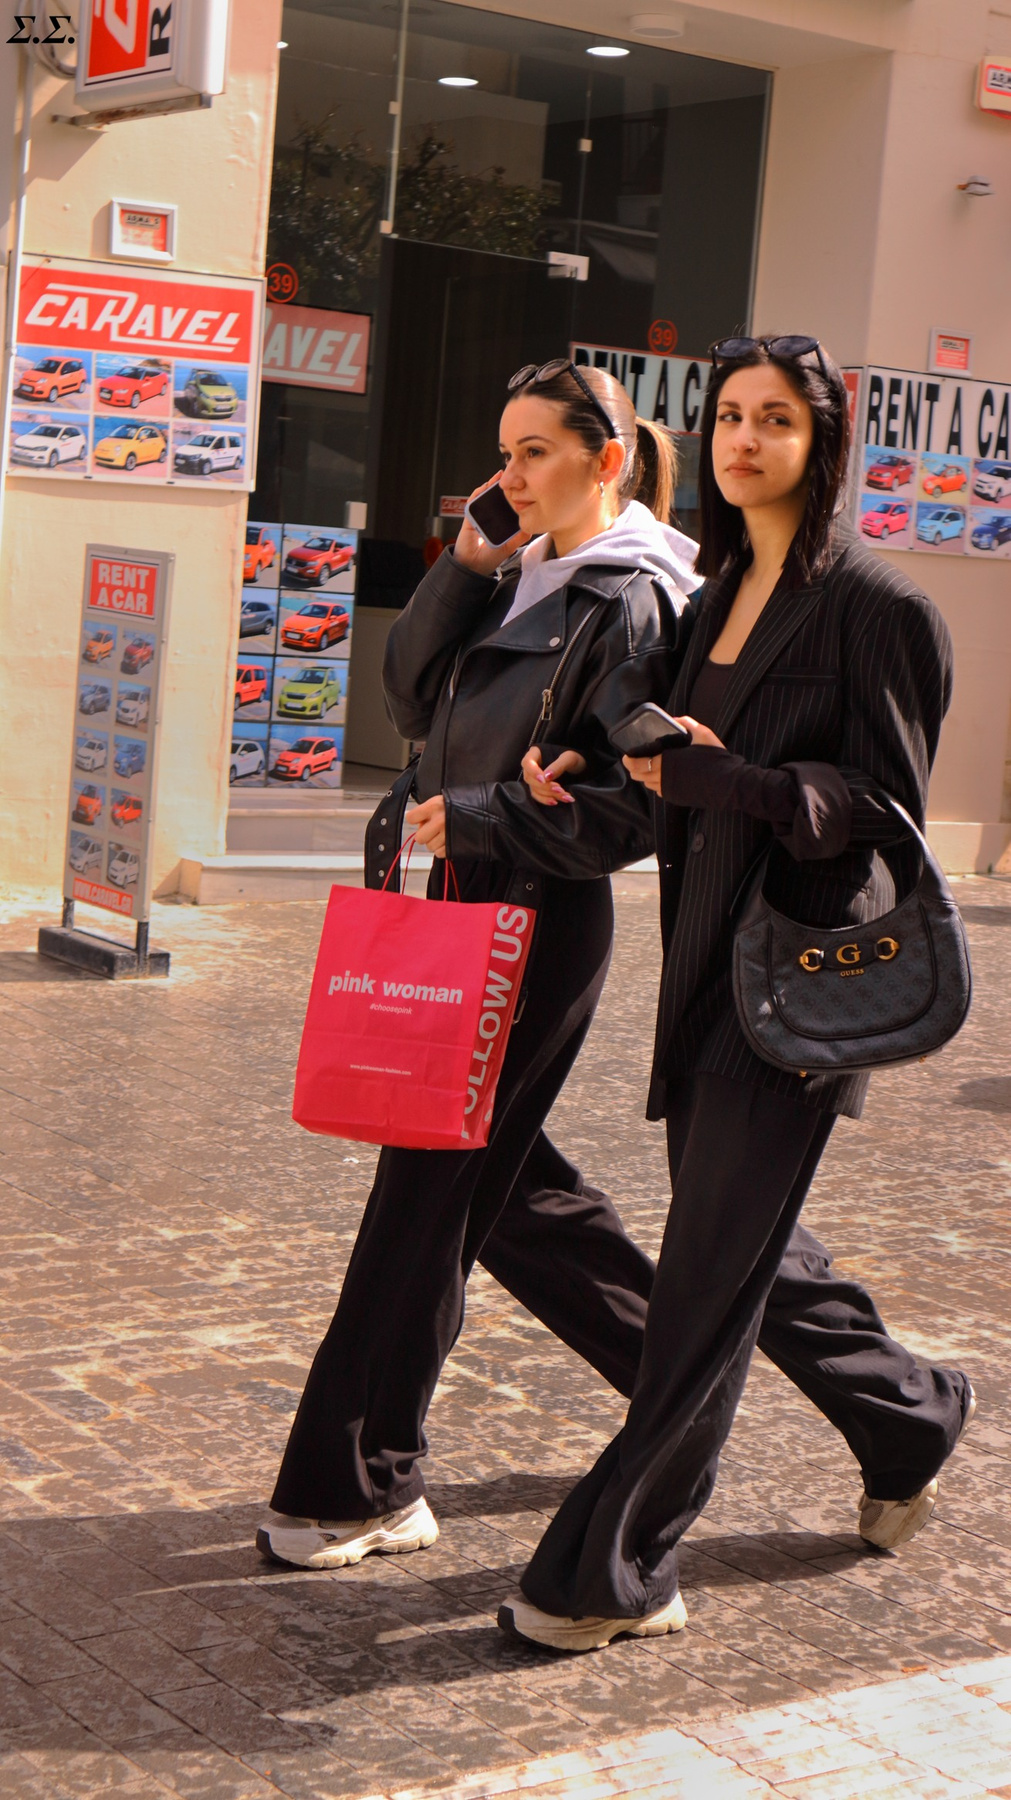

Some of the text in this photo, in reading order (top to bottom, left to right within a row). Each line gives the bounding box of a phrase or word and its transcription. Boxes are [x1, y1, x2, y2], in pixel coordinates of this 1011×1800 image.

[269, 272, 294, 293] 39
[24, 283, 243, 353] CARAVEL
[262, 307, 363, 386] AVEL
[653, 326, 673, 347] 39
[866, 375, 941, 451] RENT
[947, 386, 963, 456] A
[98, 563, 150, 590] RENT
[97, 587, 148, 613] A CAR
[491, 905, 529, 962] US
[841, 968, 865, 977] GUESS
[328, 970, 463, 1005] pink woman
[369, 1003, 413, 1015] #choosepink
